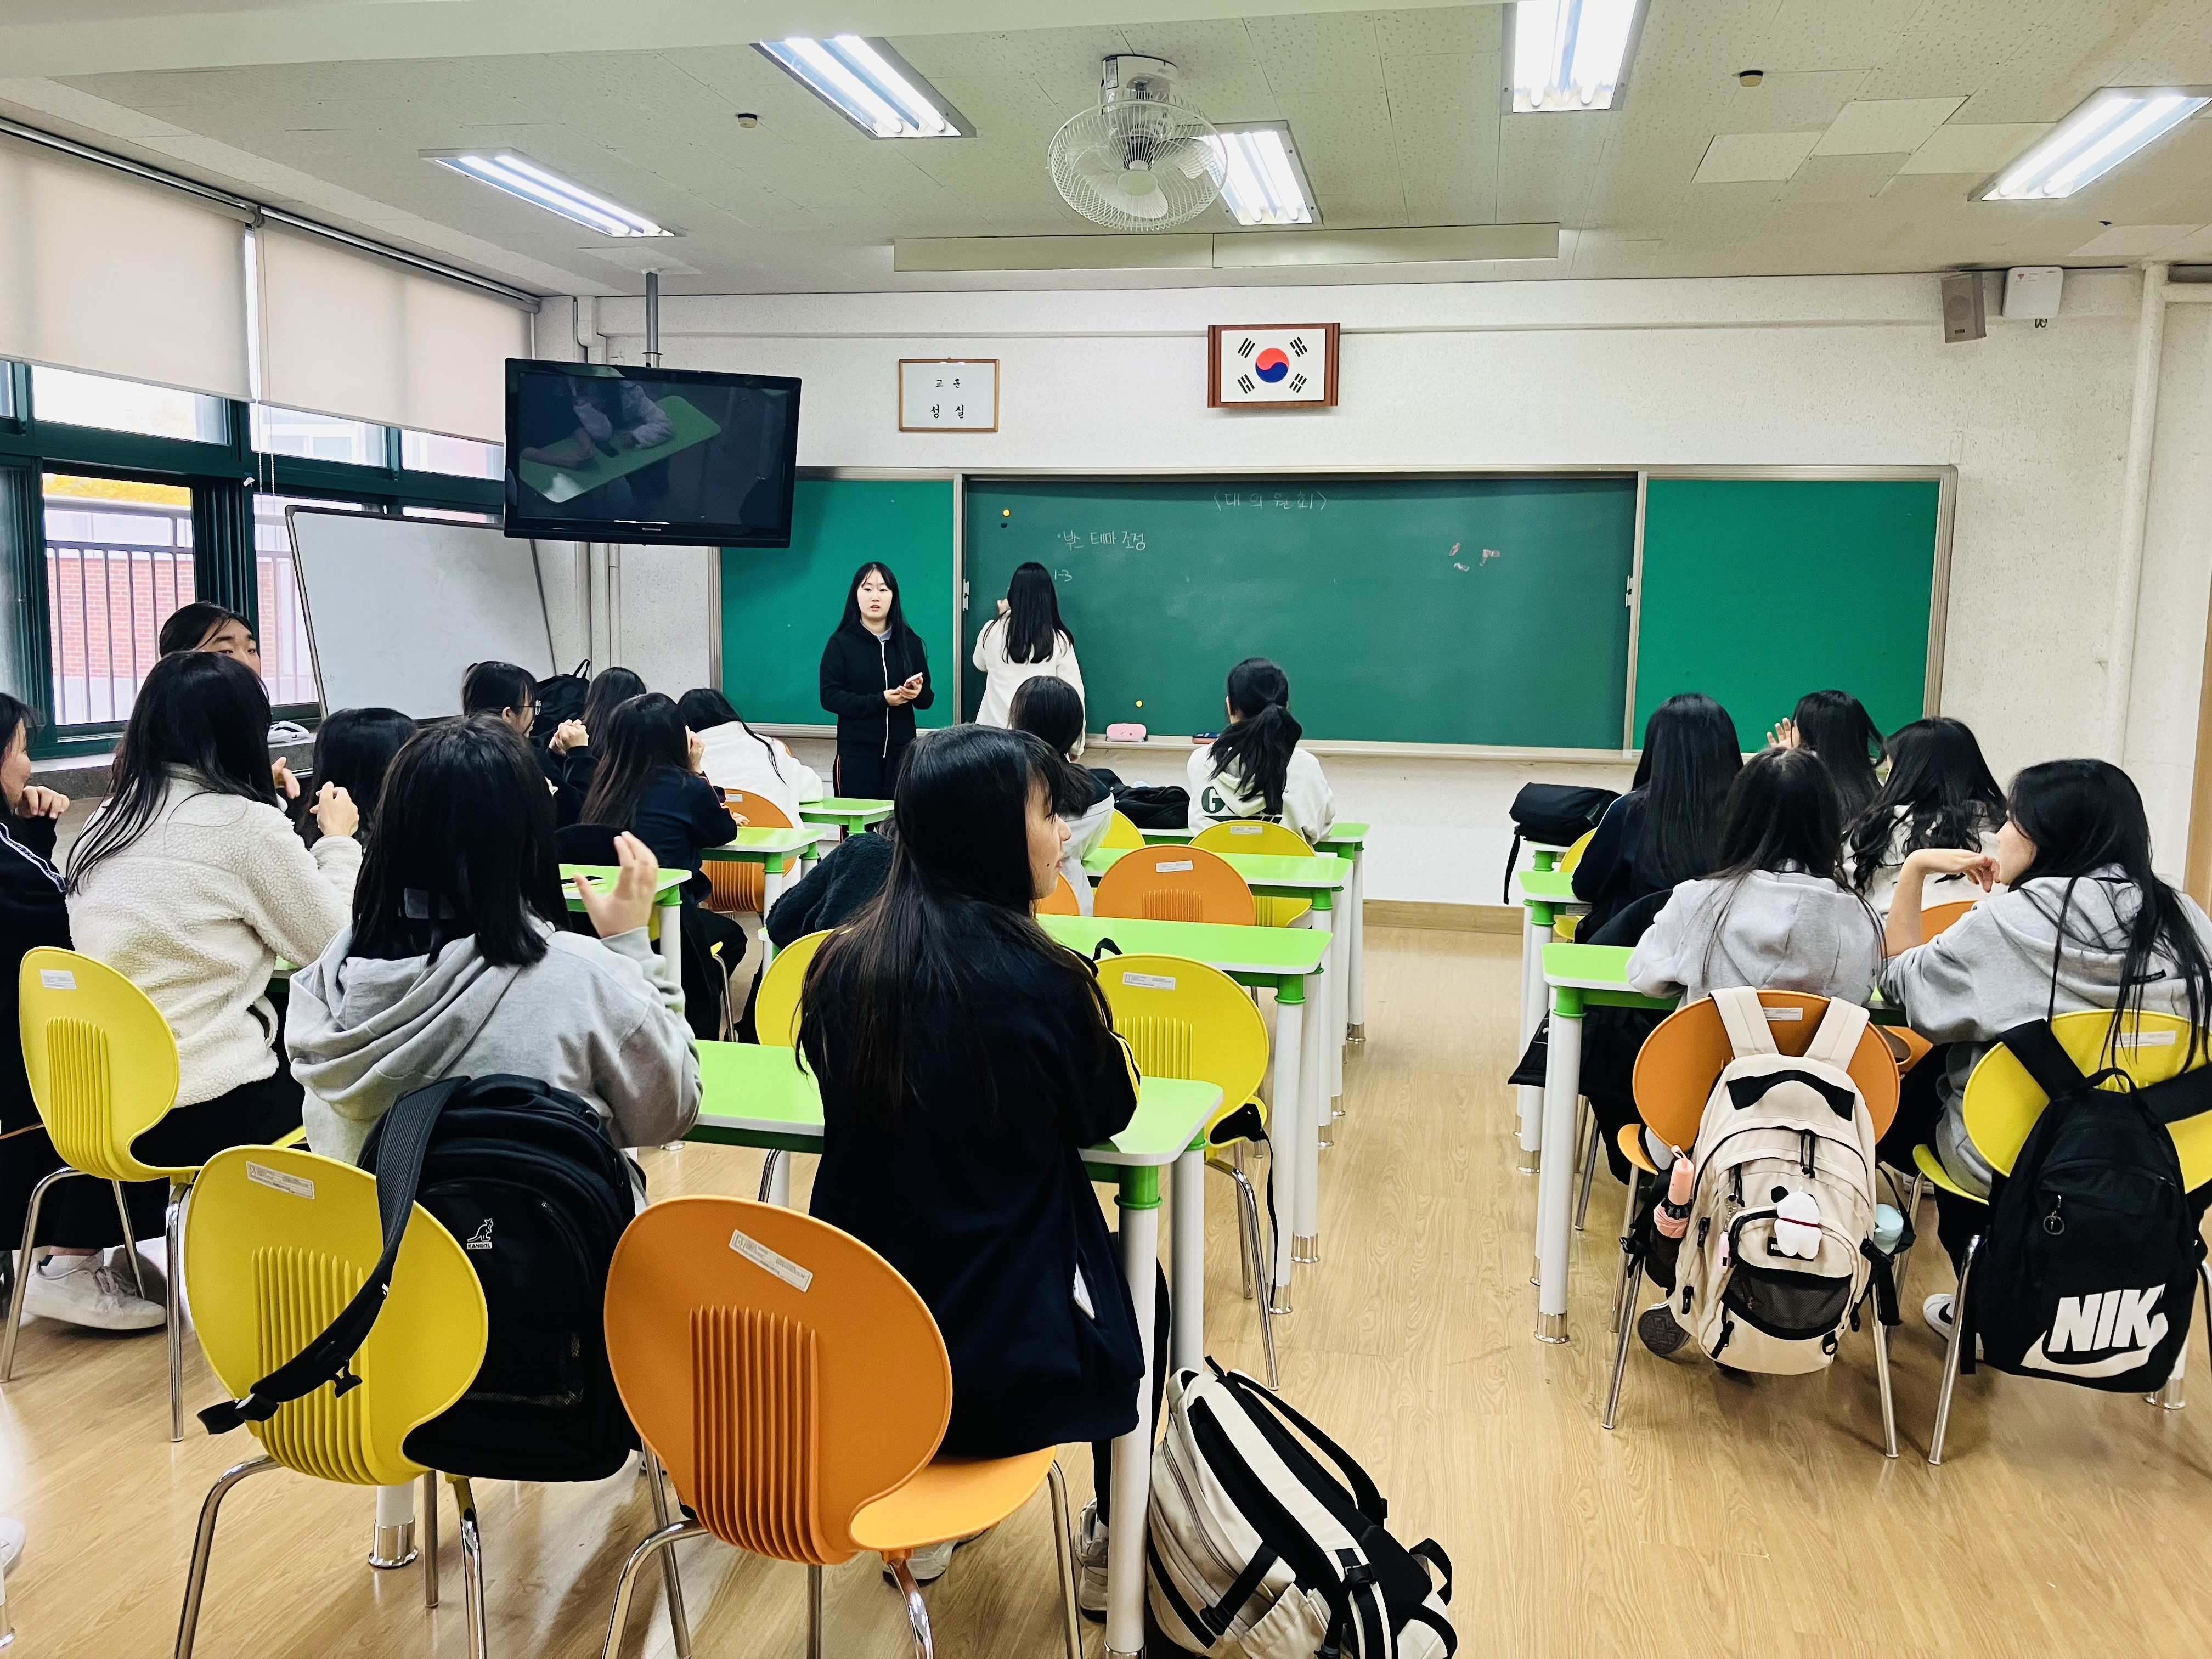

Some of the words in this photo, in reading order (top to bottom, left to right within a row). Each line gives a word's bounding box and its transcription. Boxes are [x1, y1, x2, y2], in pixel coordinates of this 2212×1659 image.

[1090, 531, 1117, 545] 테마
[1122, 531, 1146, 551] 조정
[2047, 1283, 2166, 1352] NIK
